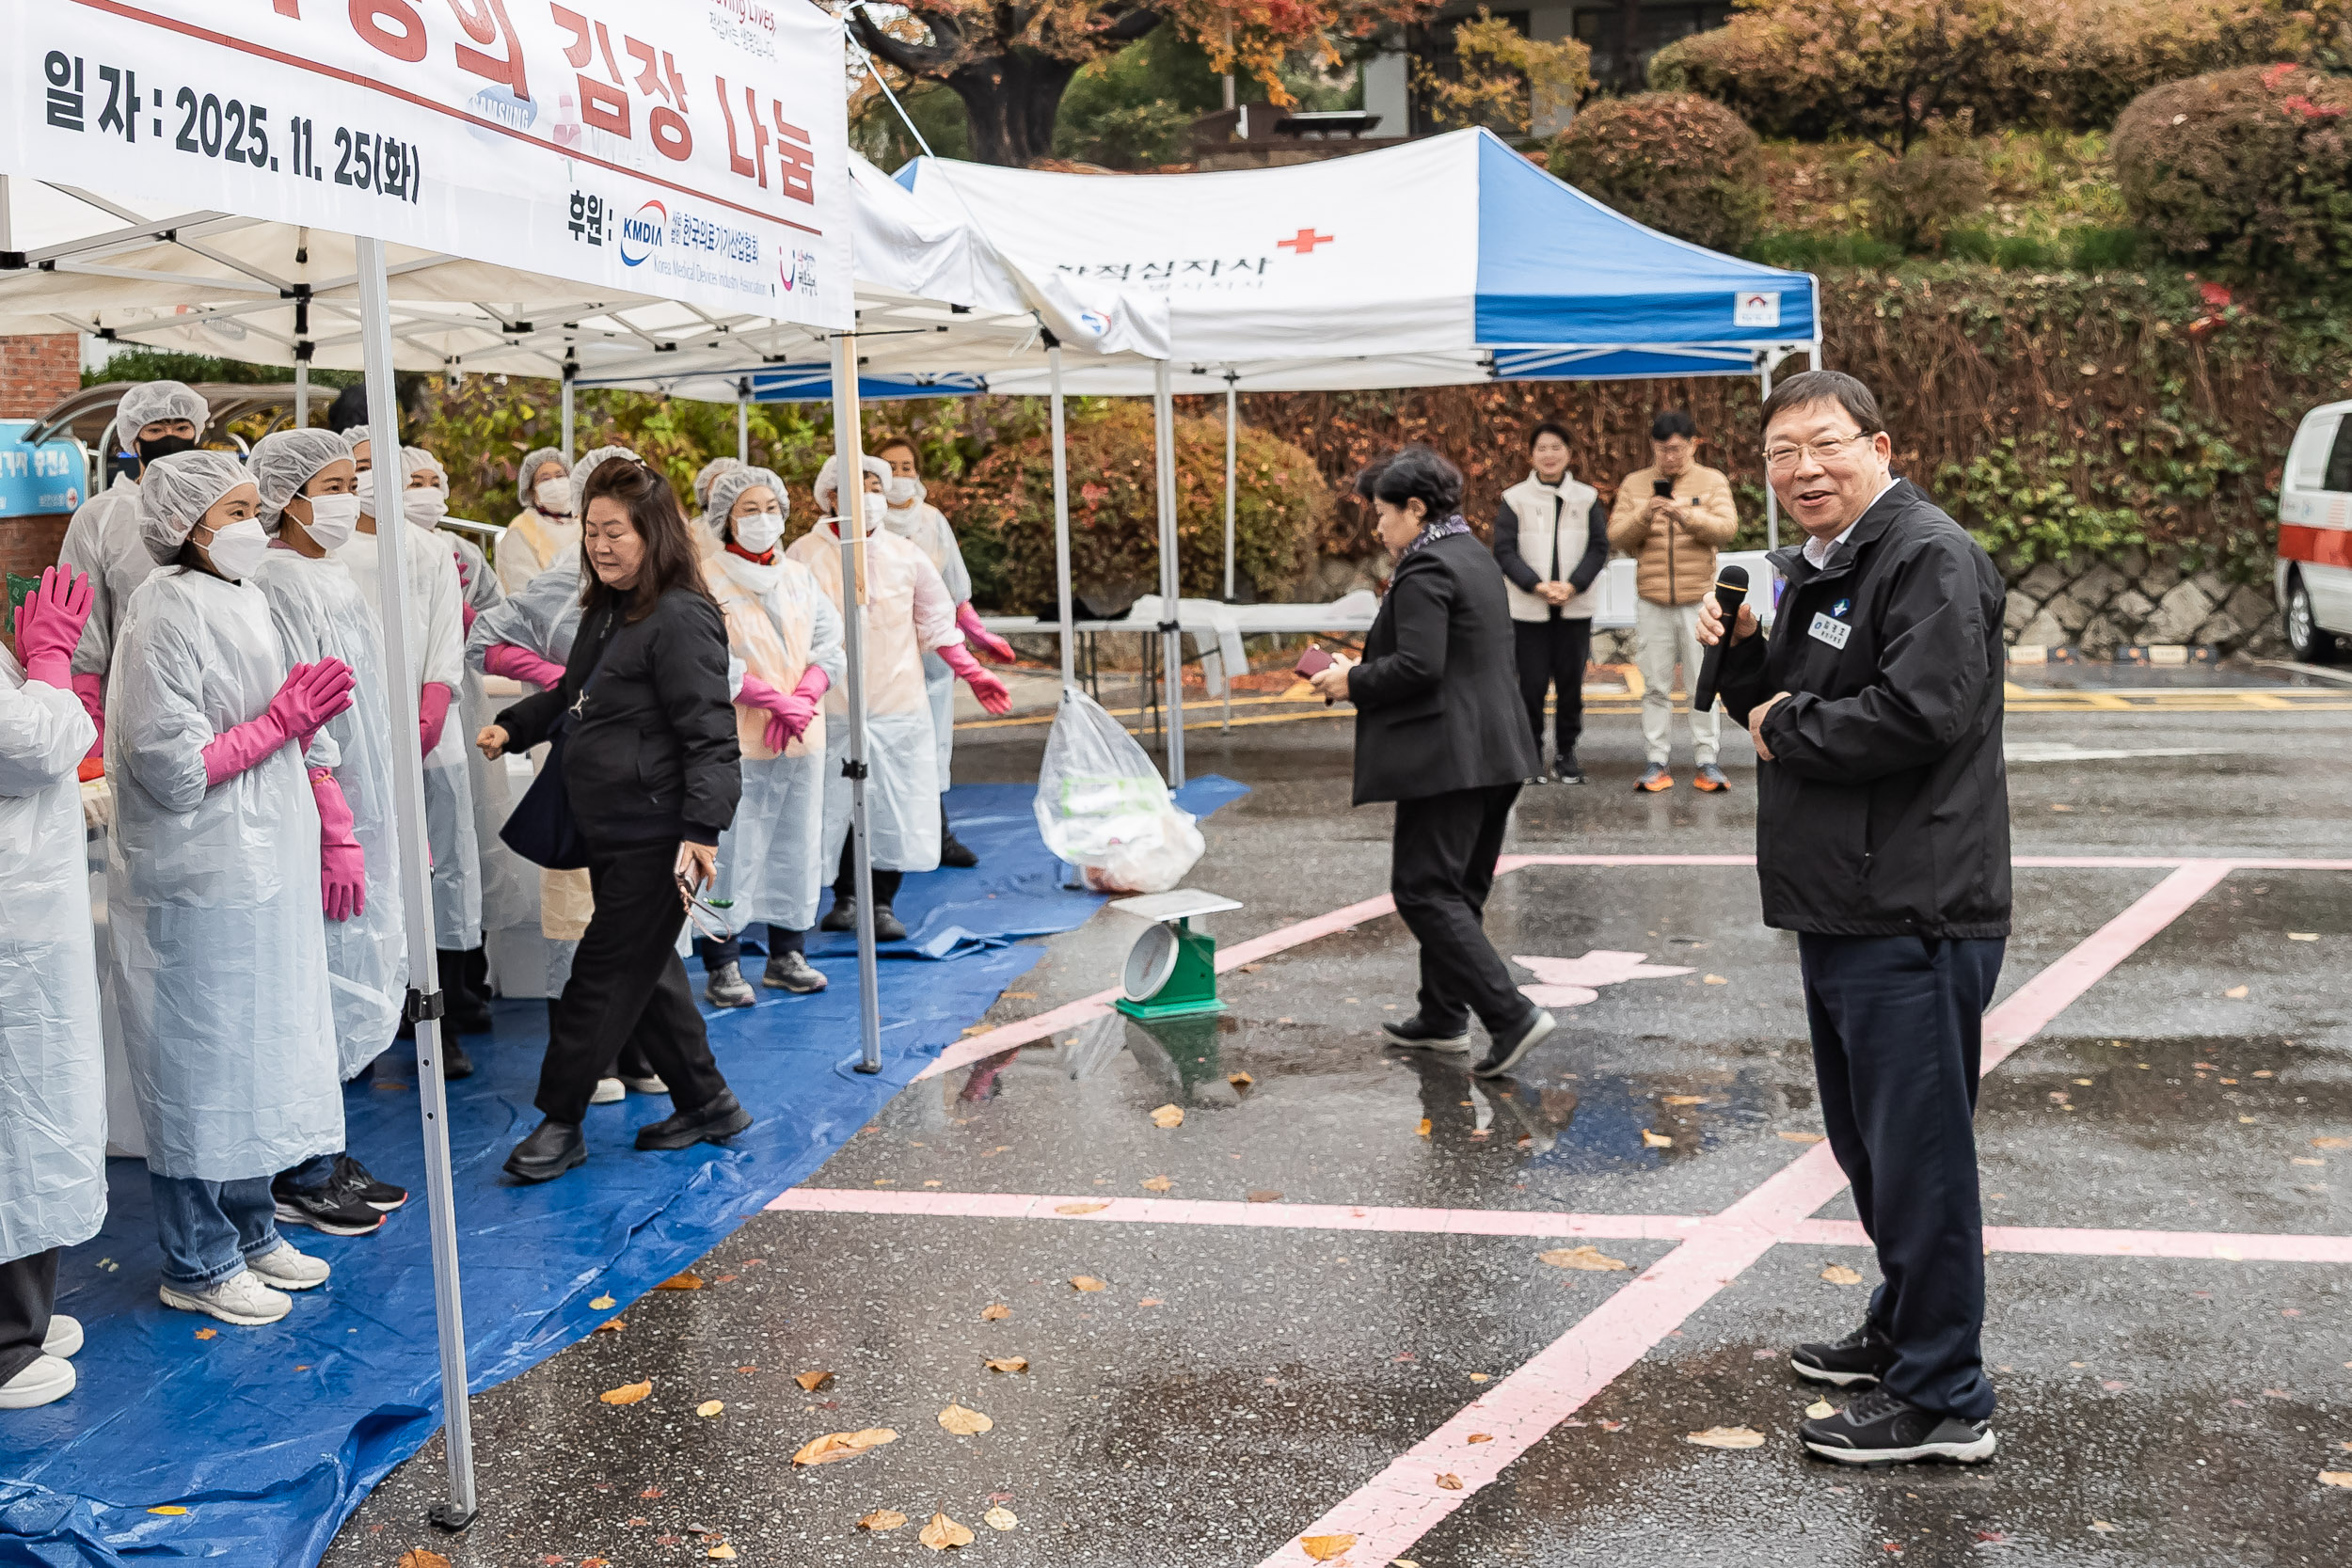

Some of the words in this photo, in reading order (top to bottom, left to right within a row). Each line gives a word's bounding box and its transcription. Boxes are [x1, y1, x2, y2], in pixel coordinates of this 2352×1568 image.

[550, 2, 693, 161] 김장
[715, 75, 815, 205] 나눔
[176, 87, 278, 172] 2025.
[291, 116, 322, 182] 11.
[334, 127, 420, 205] 25(화)
[624, 217, 662, 246] KMDIA
[683, 214, 759, 265] 한국의료기기산업협회
